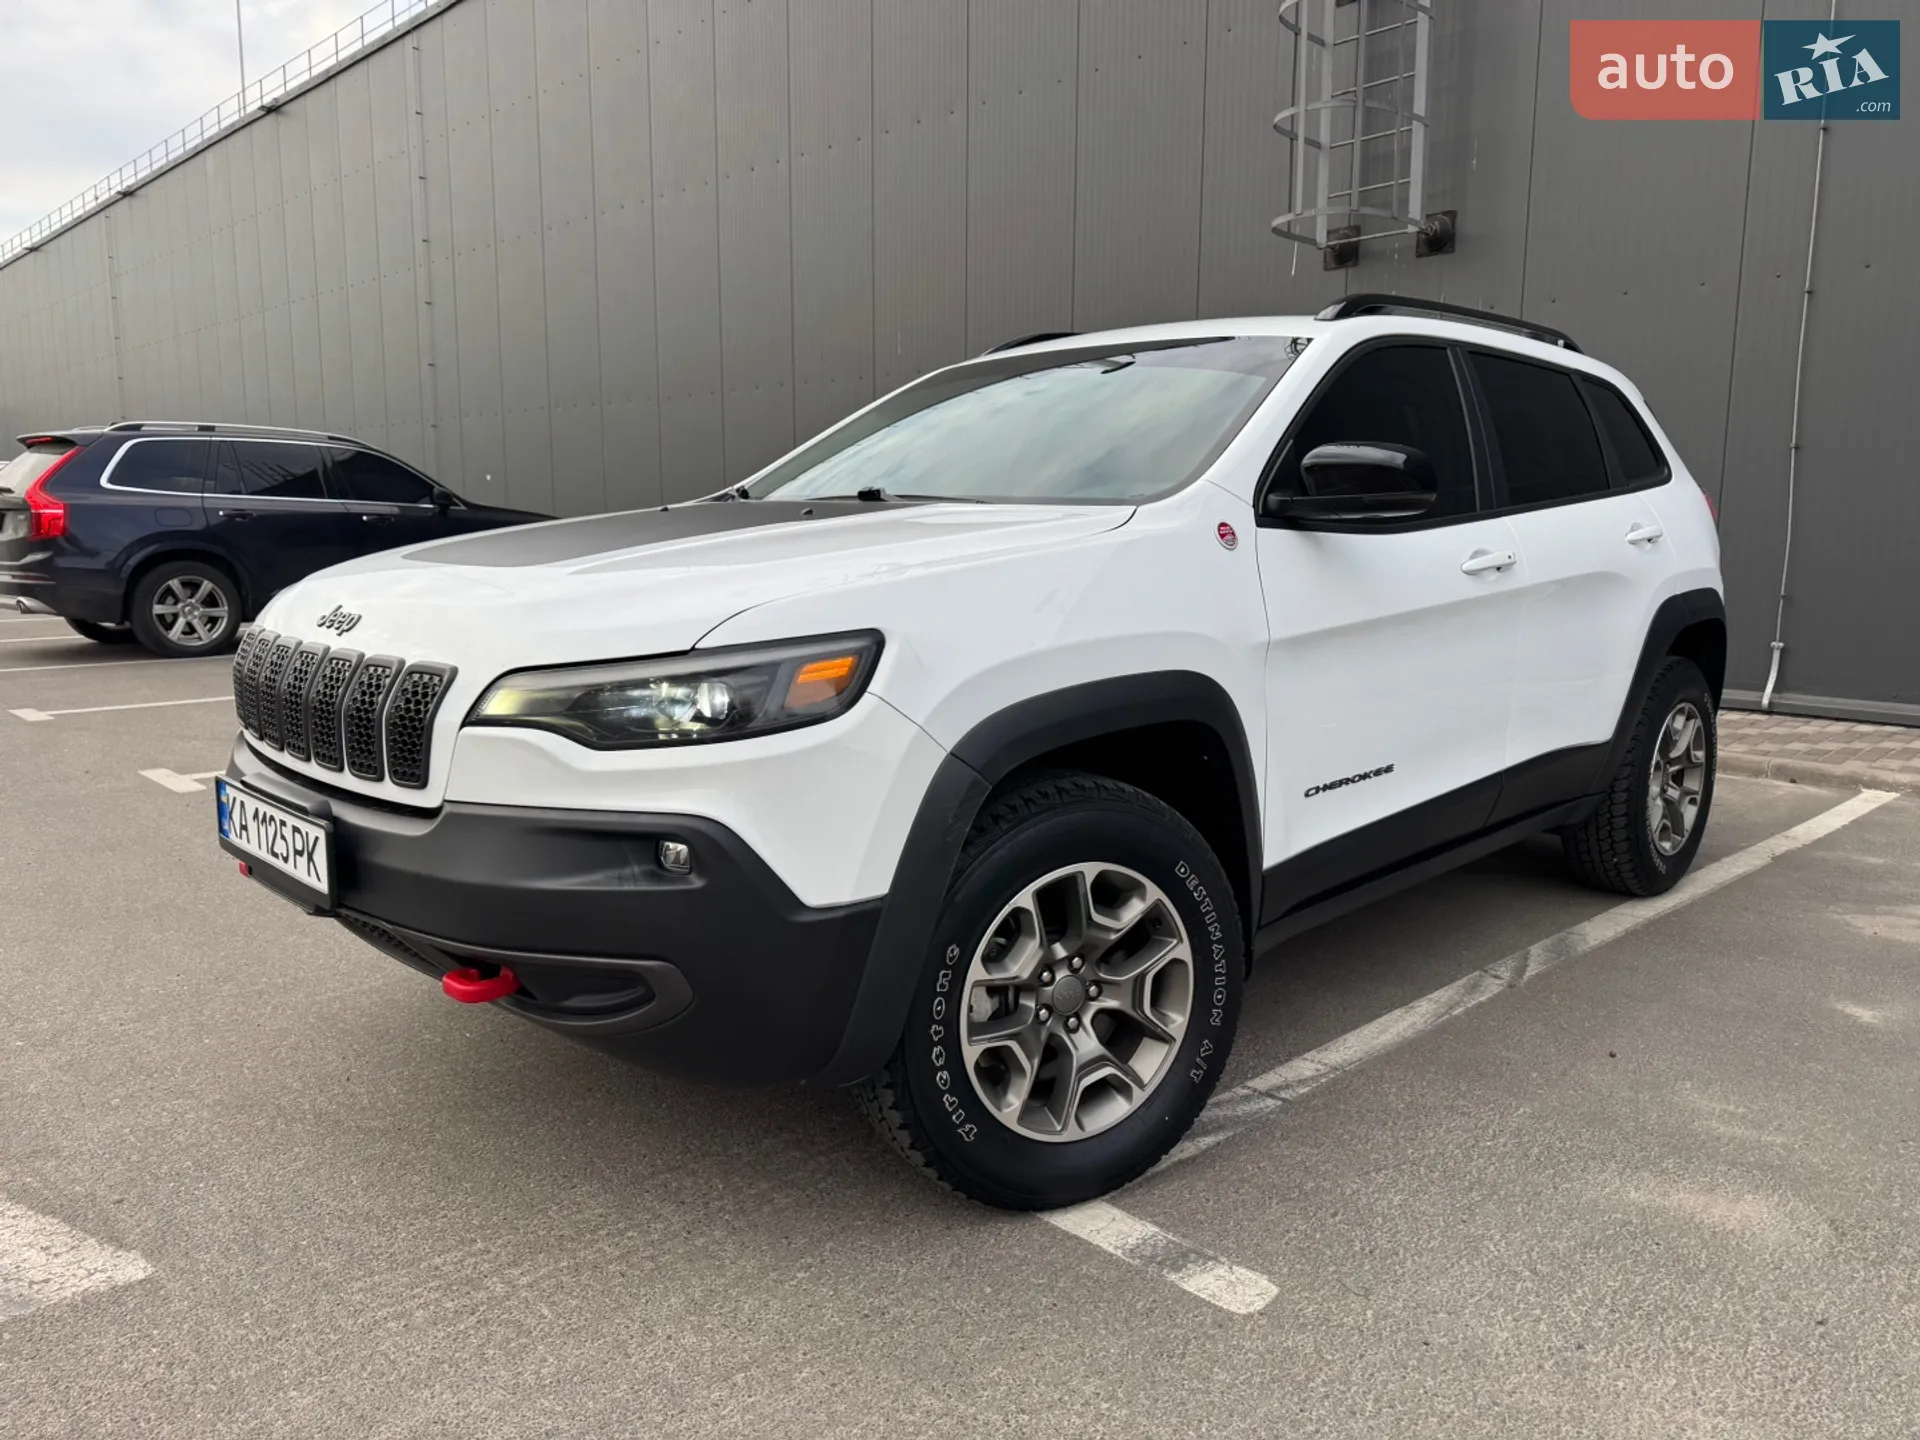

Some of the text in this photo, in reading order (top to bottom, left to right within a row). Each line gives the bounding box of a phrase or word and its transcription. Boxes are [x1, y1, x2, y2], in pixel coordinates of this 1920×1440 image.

[316, 604, 362, 637] Jeep
[1303, 763, 1395, 798] CHEROKEE
[1174, 860, 1227, 1084] DESTINATION A/T
